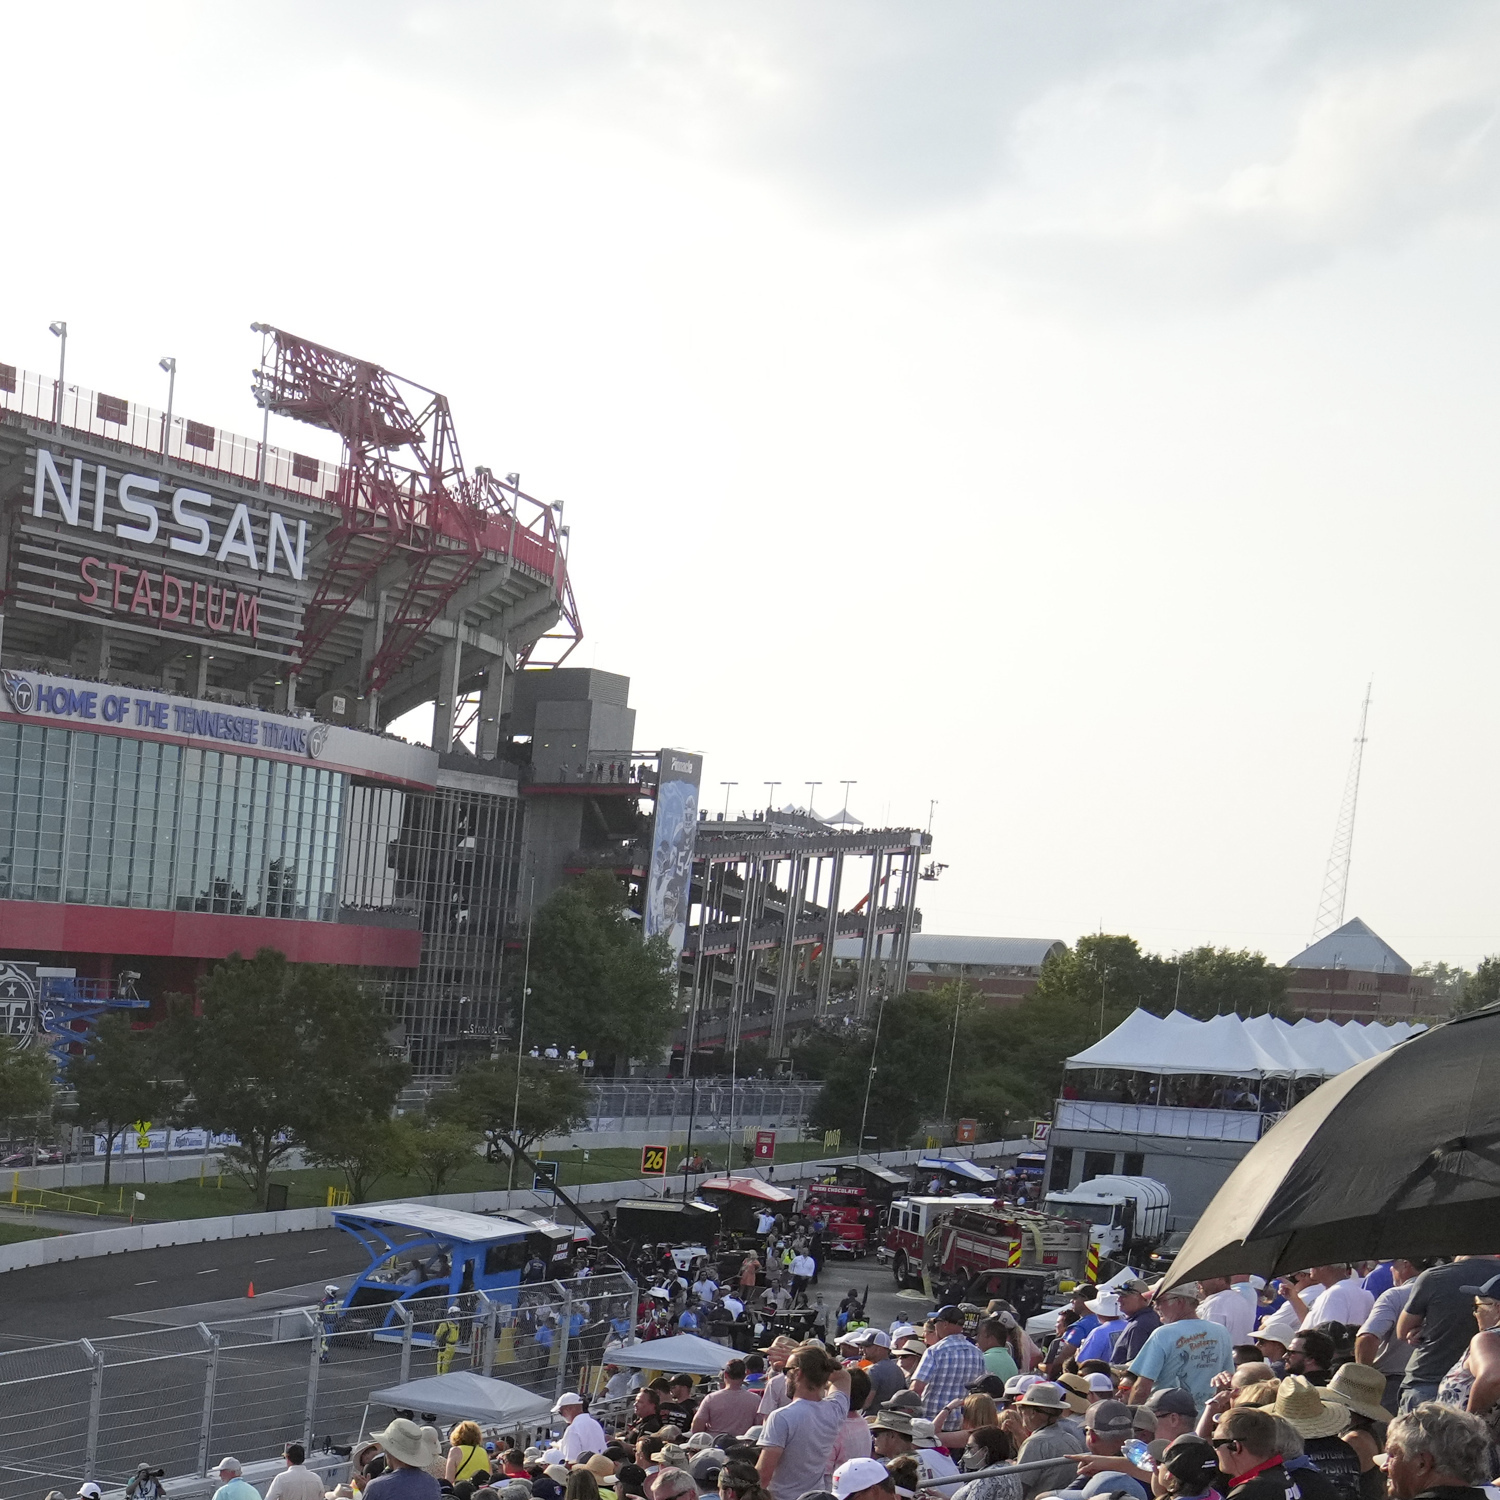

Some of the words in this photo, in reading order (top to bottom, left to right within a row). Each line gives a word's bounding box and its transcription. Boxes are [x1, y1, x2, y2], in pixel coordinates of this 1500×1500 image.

[32, 448, 307, 580] NISSAN
[78, 556, 260, 638] STADIUM
[36, 683, 98, 719] HOME
[102, 694, 131, 724] OF
[134, 698, 169, 731] THE
[172, 704, 259, 746] TENNESSEE
[261, 719, 308, 753] TITANS
[1034, 1124, 1051, 1139] 27
[761, 1144, 768, 1155] 8
[645, 1150, 664, 1170] 26
[827, 1186, 859, 1195] CHOCOLATE
[863, 1208, 870, 1216] 8
[679, 1259, 687, 1269] 2
